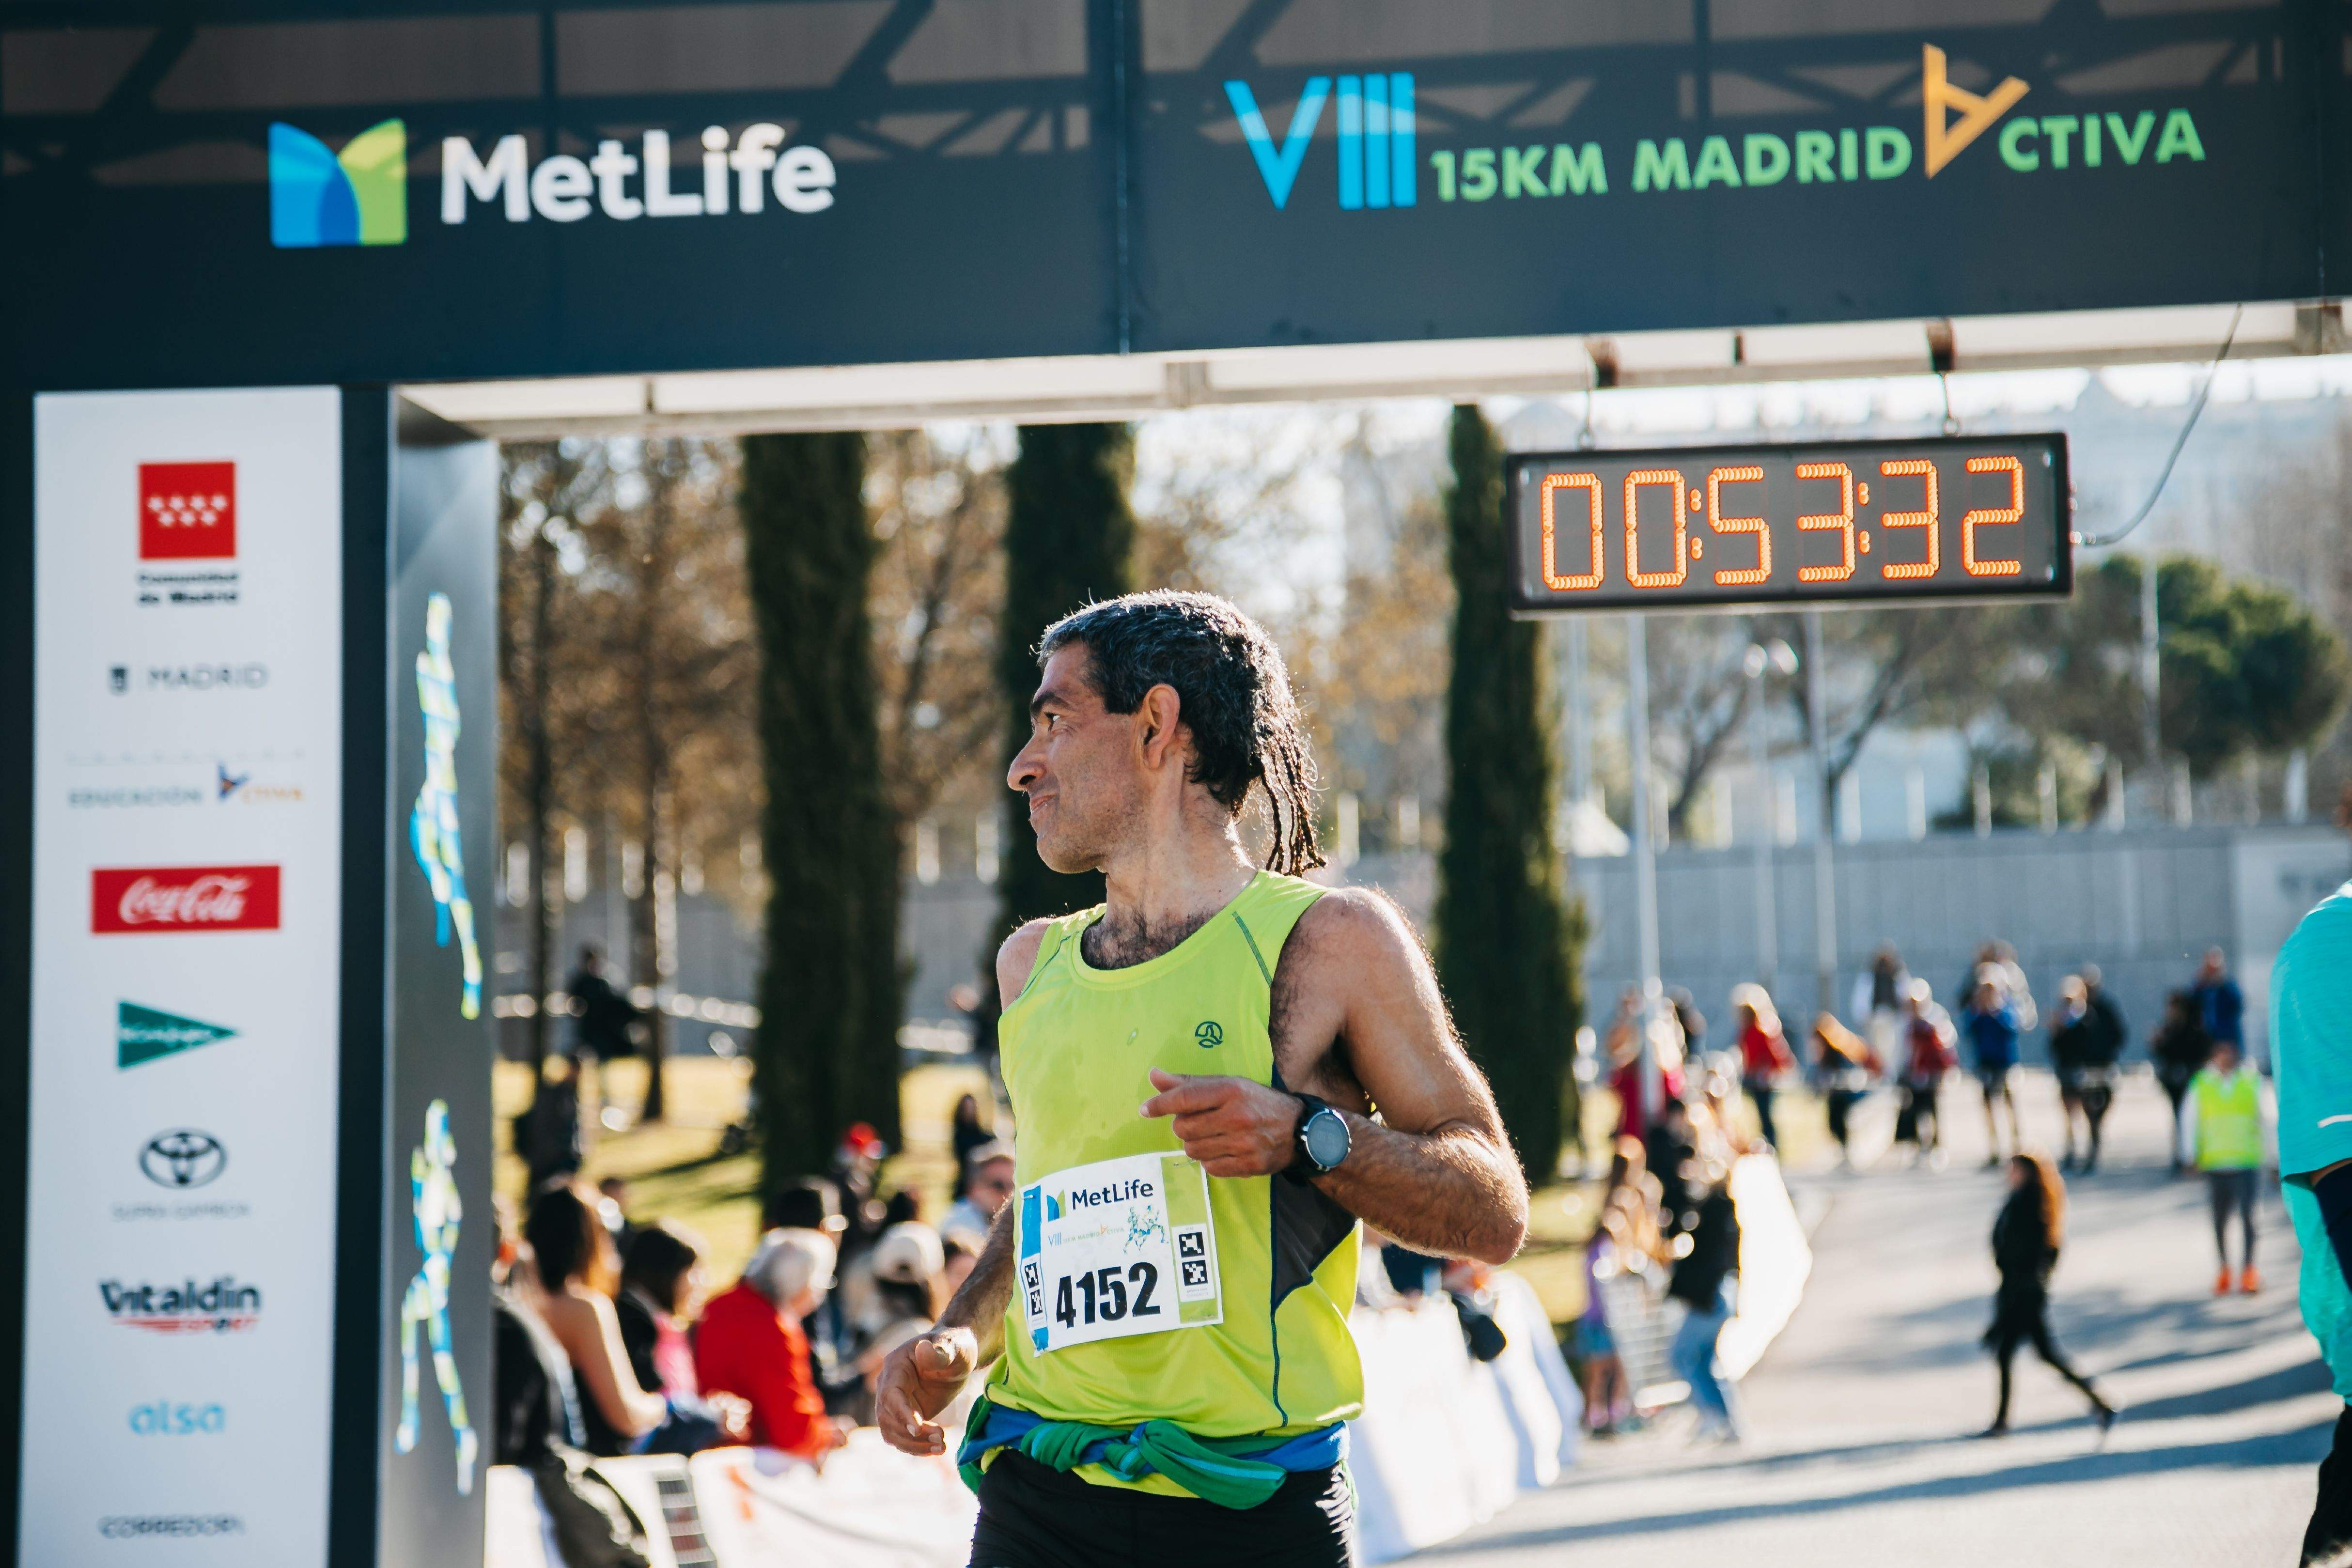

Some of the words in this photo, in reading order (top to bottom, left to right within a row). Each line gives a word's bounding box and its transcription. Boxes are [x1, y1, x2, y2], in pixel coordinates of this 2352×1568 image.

[1222, 72, 1416, 211] VIII
[1429, 142, 1608, 202] 15KM
[1631, 126, 1913, 193] MADRID
[440, 122, 837, 224] MetLife
[1542, 455, 2025, 590] 00:53:32
[147, 664, 268, 690] MADRID
[1072, 1179, 1153, 1210] MetLife
[1048, 1232, 1062, 1246] VIII
[1077, 1231, 1100, 1242] MADRID
[99, 1276, 261, 1315] Vitaldin
[1056, 1261, 1161, 1330] 4152
[128, 1401, 225, 1435] alsa
